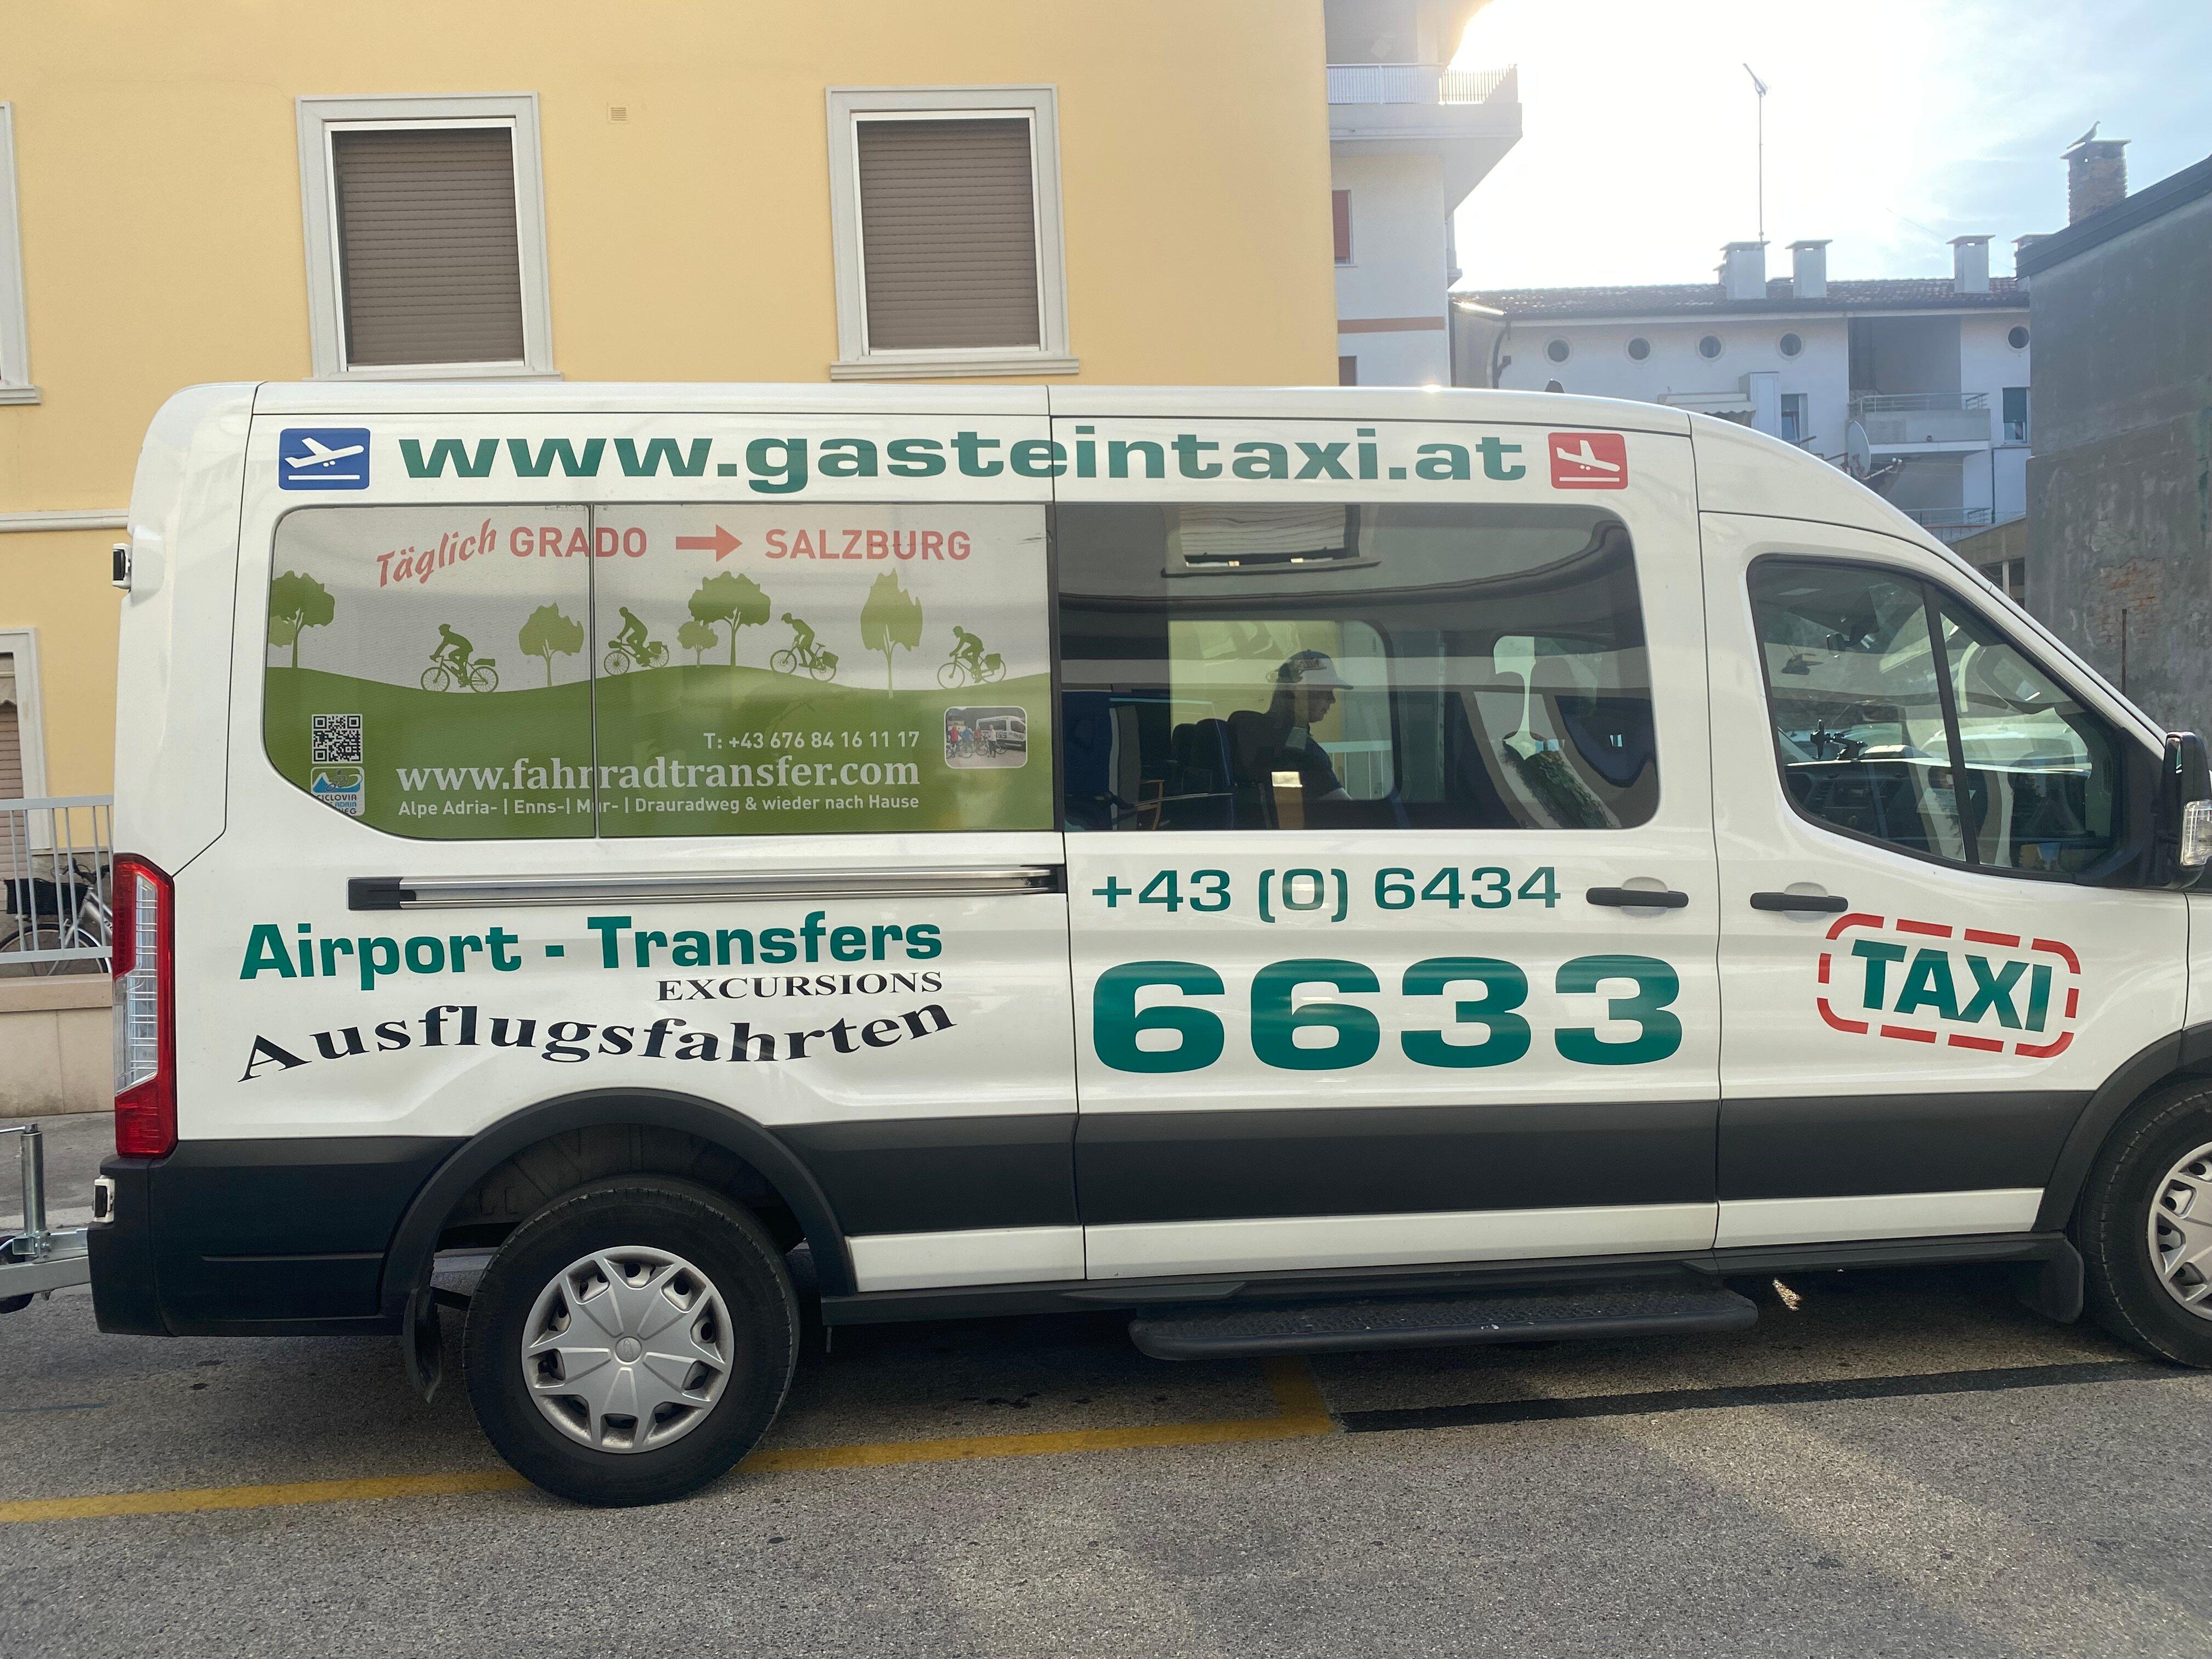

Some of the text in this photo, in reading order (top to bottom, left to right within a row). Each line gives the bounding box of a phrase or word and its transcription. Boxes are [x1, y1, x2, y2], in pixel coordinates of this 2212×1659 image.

[399, 425, 1526, 494] www.gasteintaxi.at
[376, 518, 971, 588] Täglich GRADO SALZBURG
[396, 755, 921, 791] www.fahrradtransfer.com
[703, 731, 920, 749] T: +43 676 84 16 11 17
[398, 800, 438, 819] Alpe
[443, 800, 498, 815] Adria-
[635, 797, 740, 814] Drauradweg
[746, 797, 758, 811] &
[762, 796, 820, 810] wieder
[826, 795, 864, 809] nach
[869, 794, 919, 809] Hause
[1092, 866, 1562, 924] +43 (0) 6434
[239, 923, 522, 991] Airport
[587, 911, 943, 969] Transfers
[1851, 939, 2052, 1032] TAXI
[655, 971, 943, 1001] EXCURSIONS
[1093, 954, 1683, 1074] 6633
[238, 1003, 958, 1082] Ausflugsfahrten
